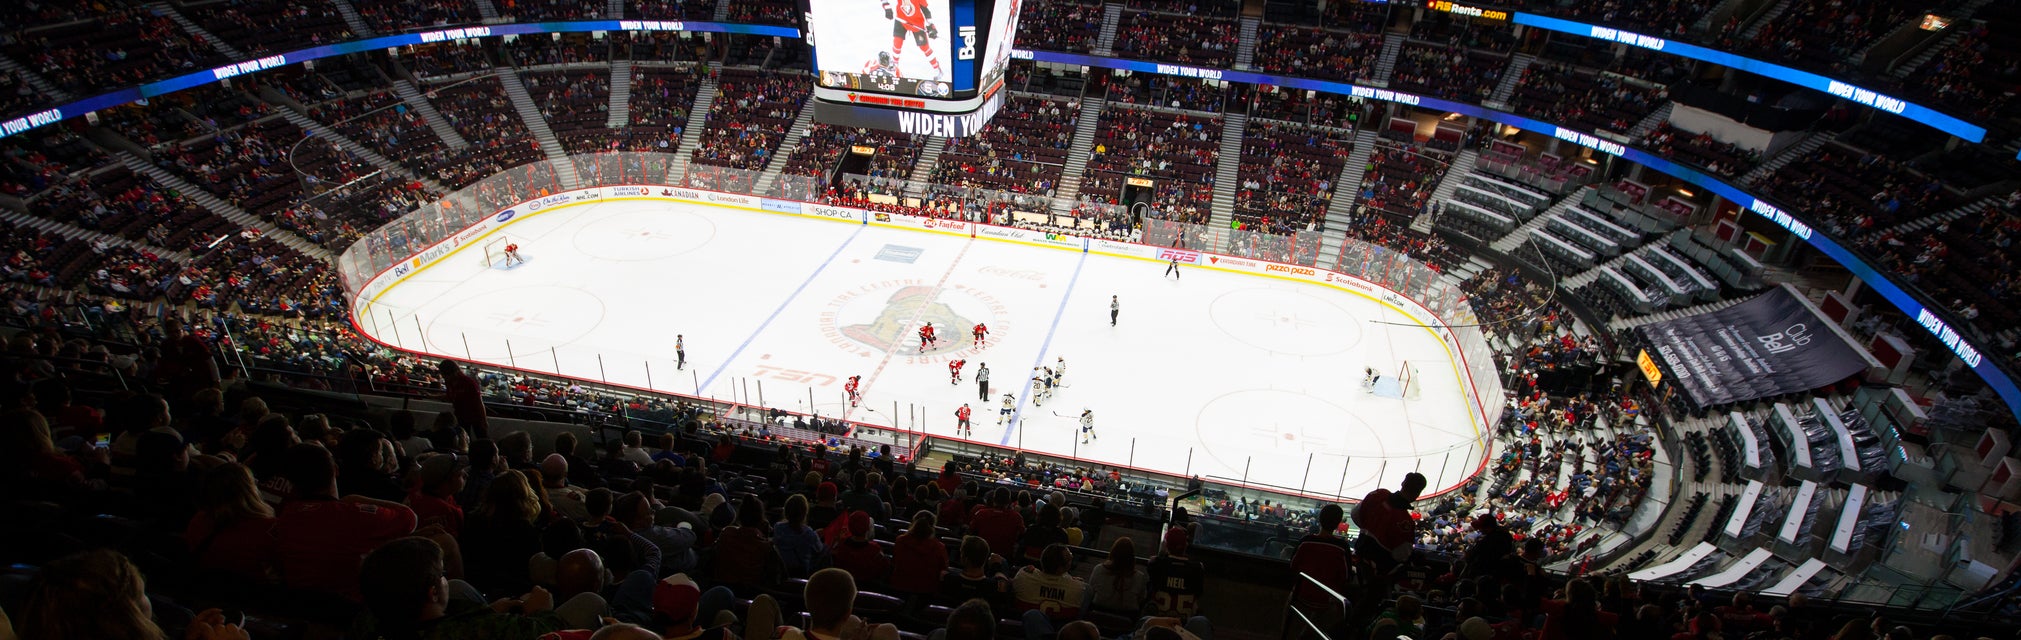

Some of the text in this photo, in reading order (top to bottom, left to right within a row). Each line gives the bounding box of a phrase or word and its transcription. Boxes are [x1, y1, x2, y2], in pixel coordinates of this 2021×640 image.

[420, 26, 491, 43] WIDEN YOUR WORLD
[620, 20, 684, 31] WIDEN YOUR WORLD
[959, 26, 976, 61] Bell
[1591, 25, 1665, 51] WIDEN YOUR WORLD
[1011, 49, 1034, 60] WORLD
[213, 54, 286, 80] WIDEN YOUR WORLD
[1157, 63, 1223, 80] WIDEN YOUR WORLD
[924, 83, 932, 93] 5
[1352, 85, 1420, 106] WIDEN YOUR WORLD
[1828, 80, 1906, 114] WIDEN YOUR WORLD
[2, 117, 30, 136] YOUR
[27, 108, 62, 128] WORLD
[898, 110, 955, 137] WIDEN
[1554, 126, 1626, 156] WIDEN YOUR WORLD
[671, 189, 700, 200] CANADIAN
[716, 196, 738, 204] London
[1751, 198, 1812, 240] WIDEN YOUR WORLD
[420, 245, 450, 265] Mark's
[394, 263, 409, 278] Bell
[1265, 263, 1315, 277] pizza pizza
[1335, 276, 1373, 293] Scotiabank
[1757, 332, 1796, 354] Bell
[1785, 323, 1813, 346] Club
[1917, 308, 1982, 368] WIDEN YOUR WORLD
[753, 364, 837, 387] TSN
[1641, 354, 1657, 380] TSN
[1039, 585, 1066, 601] RYAN
[1166, 576, 1186, 590] NEIL
